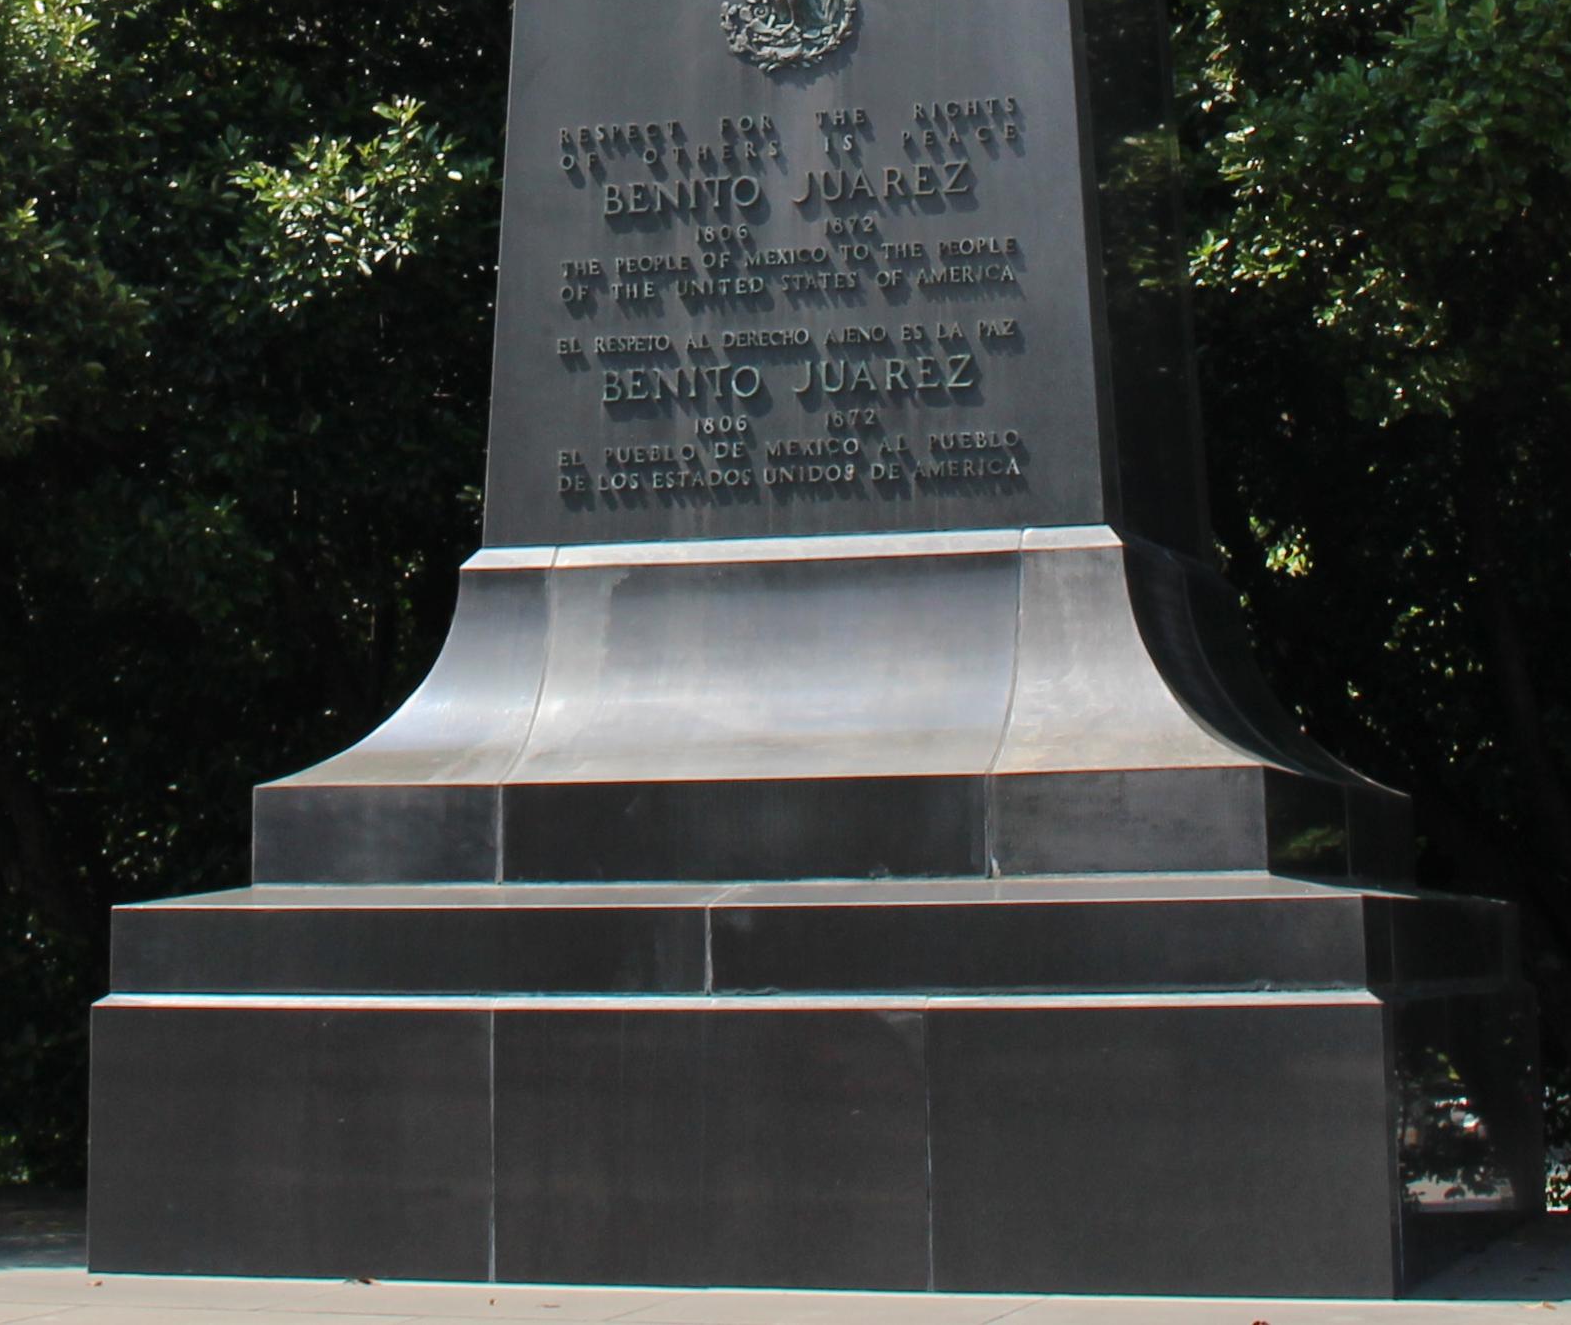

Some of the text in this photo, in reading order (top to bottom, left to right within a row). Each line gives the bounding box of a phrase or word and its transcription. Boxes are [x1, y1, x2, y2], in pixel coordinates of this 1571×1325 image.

[560, 96, 1017, 143] RESPECT FOR THE RIGHTS
[560, 122, 1017, 170] OF OTHERS IS PEACE
[604, 159, 970, 215] BENITO JUAREZ
[696, 216, 875, 243] 1806 1872
[562, 236, 1017, 277] THE PEOPLE OF MEXICO TO THE PEOPLE
[560, 264, 1015, 303] OF THE UNITED STATES OF AMERICA
[556, 318, 1015, 355] EL RESPETO AL DERECHO AJENO ES LA PAZ
[602, 353, 974, 402] BENITO JUAREZ
[694, 408, 875, 434] 1806 1872
[558, 429, 1019, 466] EL PUEBLO DE MEXICO AL PUEBLO
[558, 457, 1021, 492] DE LOS ESTADOS UNIDOS DE AMERICA
